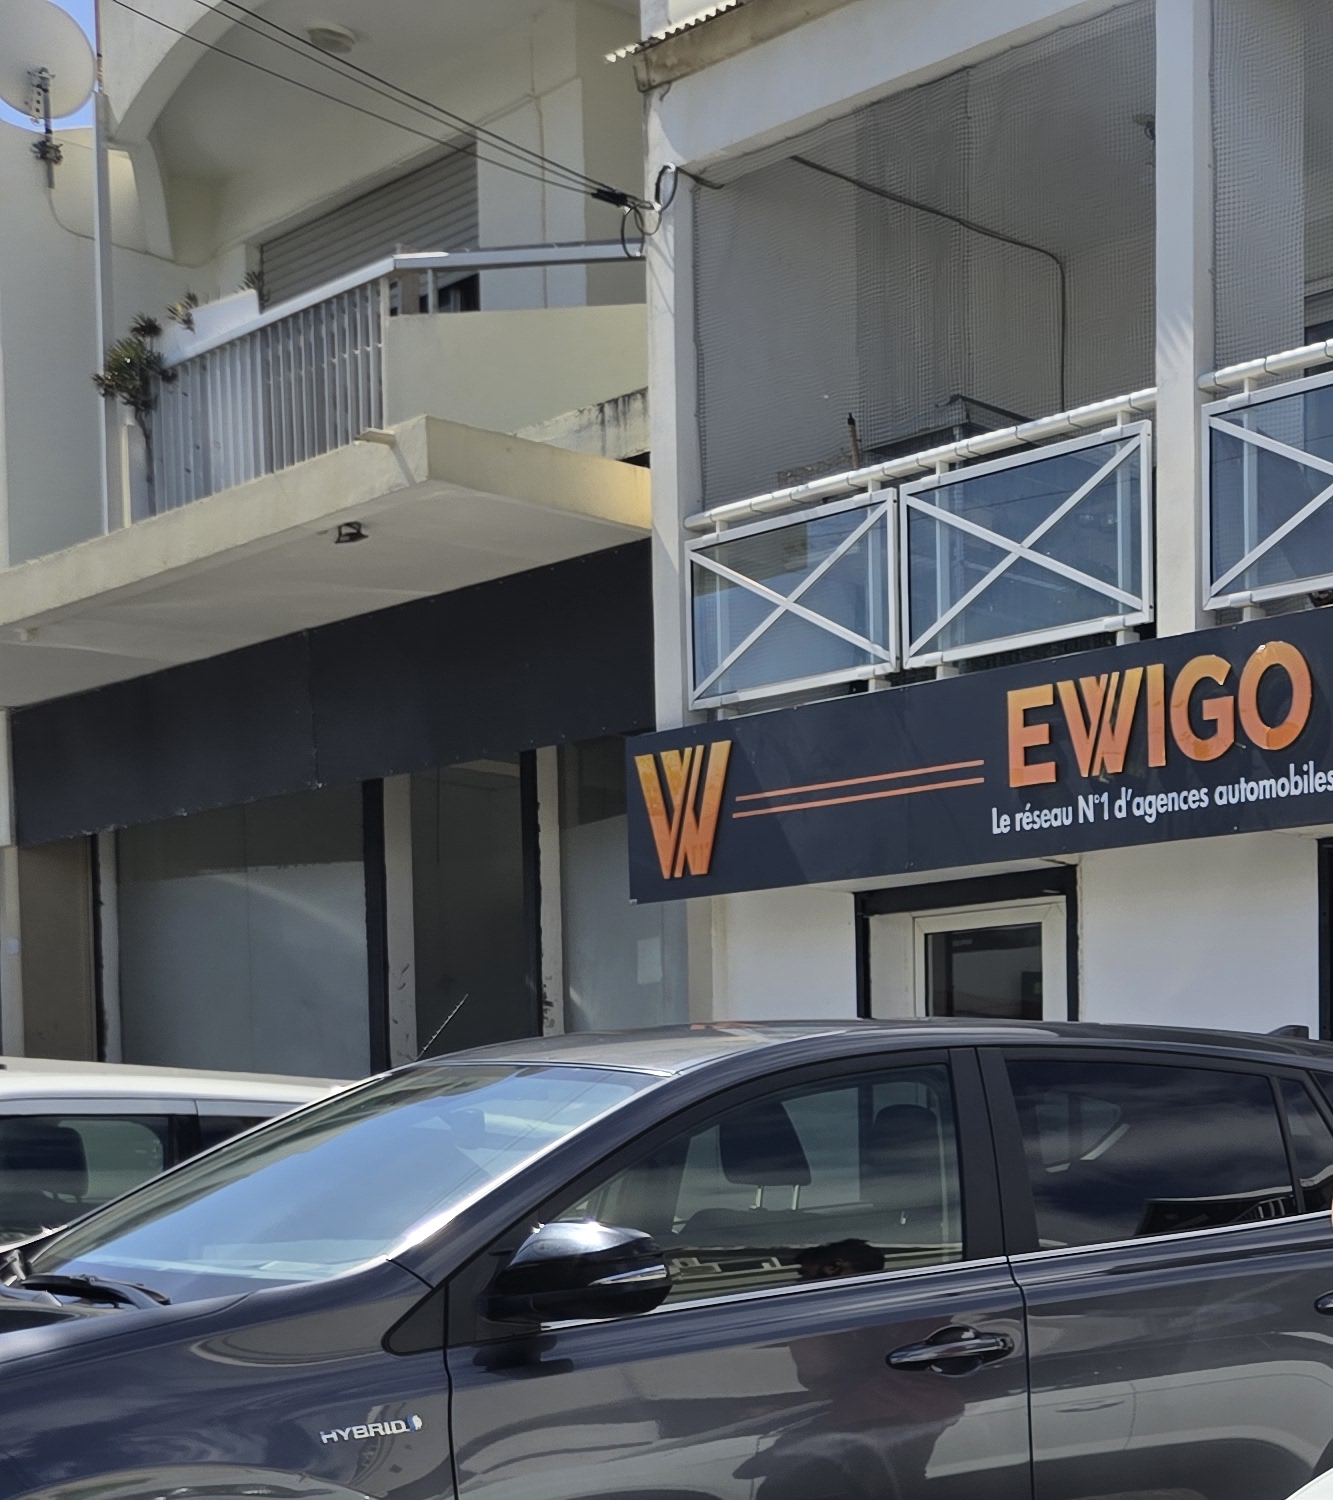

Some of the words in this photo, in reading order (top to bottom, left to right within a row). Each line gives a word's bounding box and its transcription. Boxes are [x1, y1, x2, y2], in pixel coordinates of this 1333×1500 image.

[1007, 640, 1312, 788] EWIGO
[992, 807, 1011, 834] Le
[1015, 803, 1073, 831] réseau
[1078, 792, 1109, 823] N°1
[1114, 786, 1208, 823] d'agences
[320, 1420, 409, 1443] HYBRID
